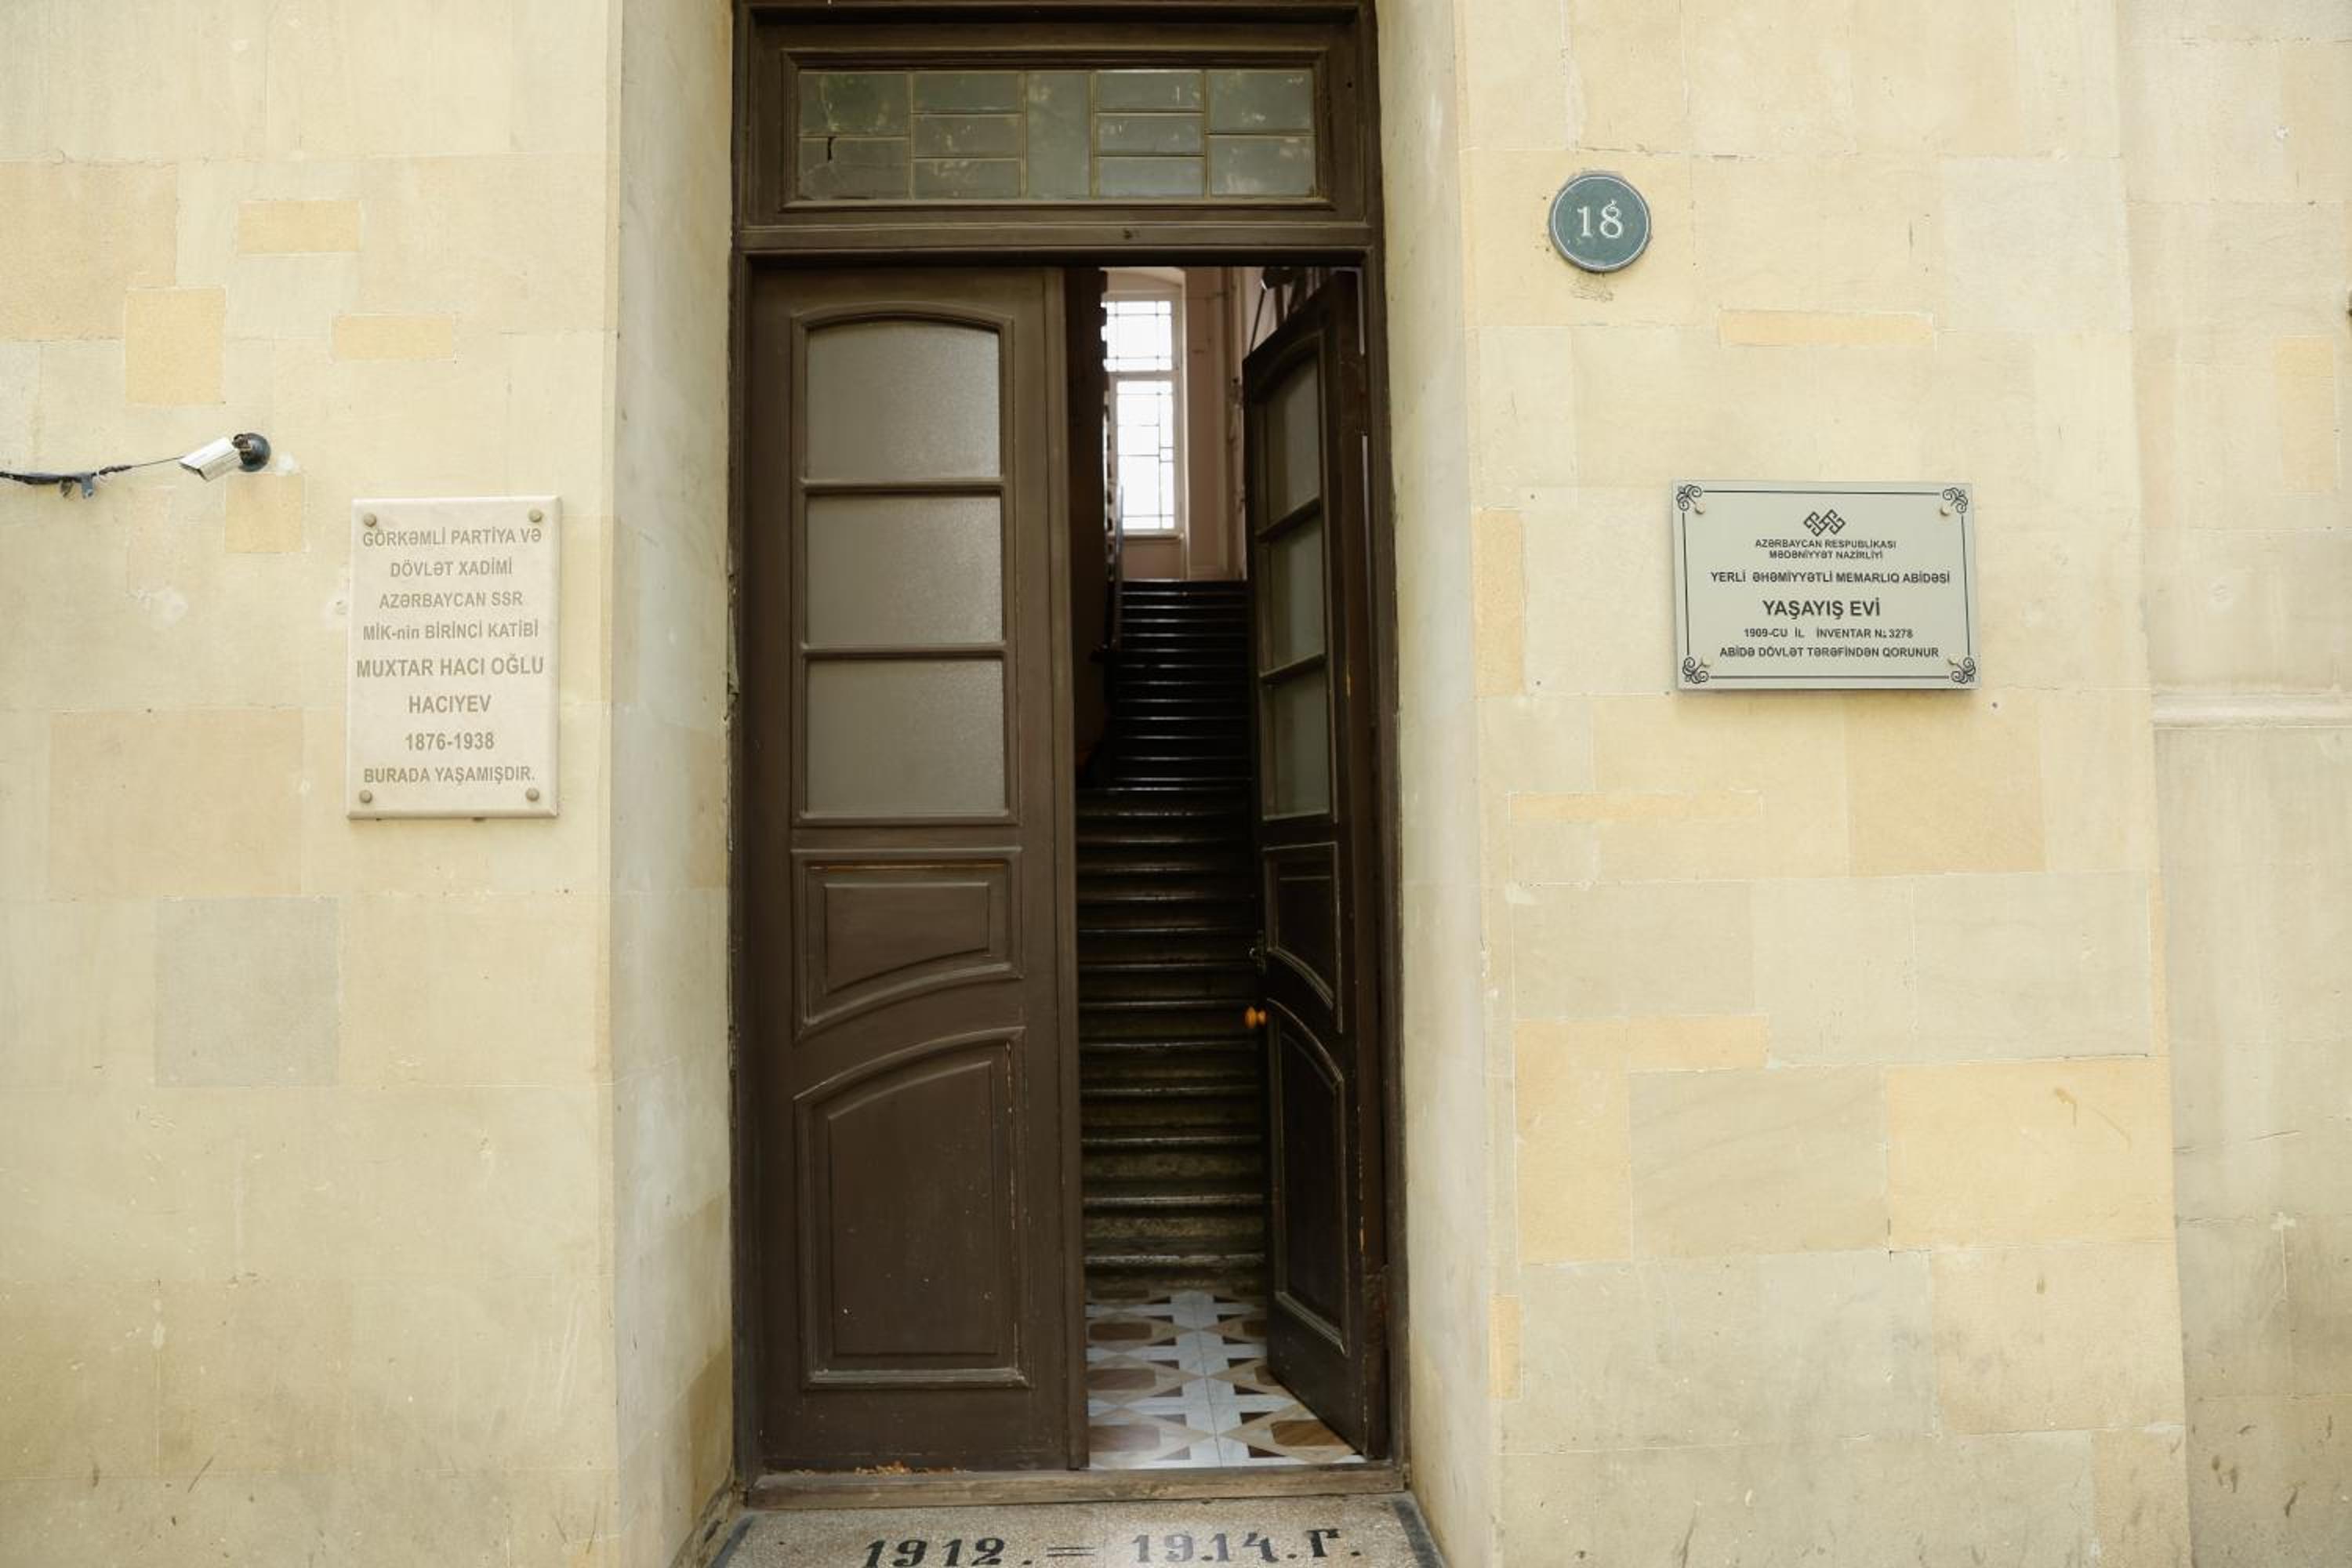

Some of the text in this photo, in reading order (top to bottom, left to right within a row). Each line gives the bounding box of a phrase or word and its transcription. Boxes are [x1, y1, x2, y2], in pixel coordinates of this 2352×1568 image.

[1577, 198, 1624, 238] 18
[363, 526, 543, 546] GÖRKƏMLİ PARTİYA VƏ
[1755, 539, 1897, 549] AZƏRBAYCAN RESPUBLİKASI
[1769, 550, 1833, 559] MƏDƏNİYYƏT
[390, 556, 513, 578] DÖVLƏT XADİMİ
[1711, 570, 1951, 584] YERLİ ƏHƏMİYYƏTLİ MEMARLIQ ABİDƏSİ
[379, 592, 524, 609] AZƏRBAYCAN SSR
[1762, 597, 1881, 619] YAŞAYIŞ EVİ
[363, 618, 539, 641] MİK-nin BİRİNCİ KATİBİ
[1744, 628, 1788, 637] 1909-CU
[1795, 626, 1805, 637] İL
[1817, 626, 1871, 638] İNVENTAR
[1719, 644, 1939, 658] ABİDƏ DÖVLƏT TƏRƏFİNDƏN QORUNUR
[356, 653, 544, 678] MUXTAR HACI OĞLU
[408, 695, 492, 714] HACIYEV
[405, 731, 495, 750] 1876-1938
[364, 765, 535, 785] BURADA YAŞAMIŞDIR.
